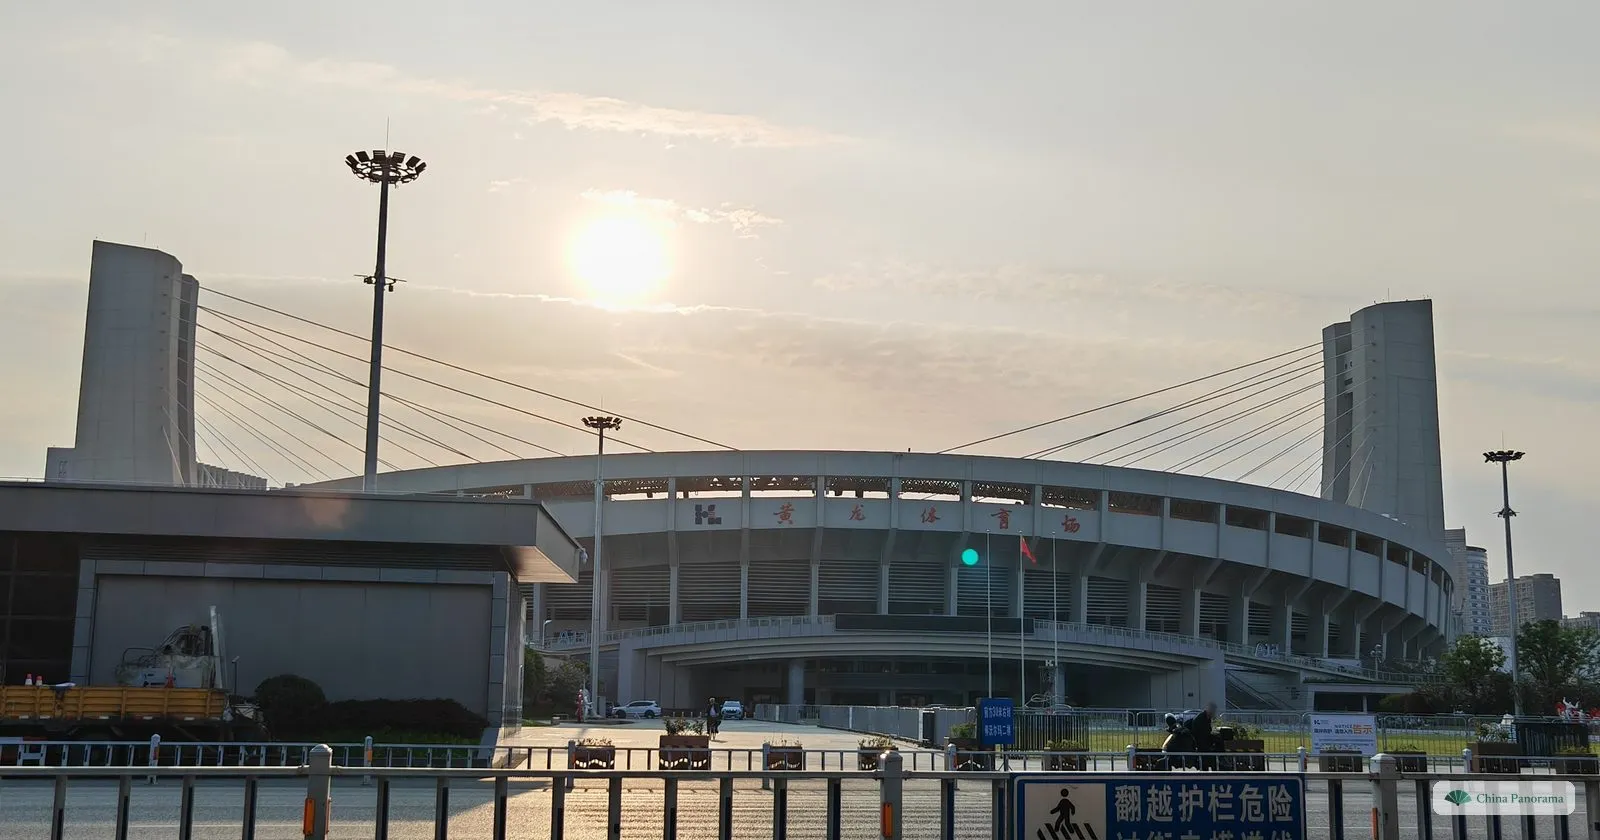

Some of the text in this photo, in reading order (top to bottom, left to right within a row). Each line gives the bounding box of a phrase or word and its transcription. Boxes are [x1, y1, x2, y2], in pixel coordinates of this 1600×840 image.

[773, 502, 1081, 534] 黄龙体育场
[1115, 784, 1294, 823] 翻越护栏危险
